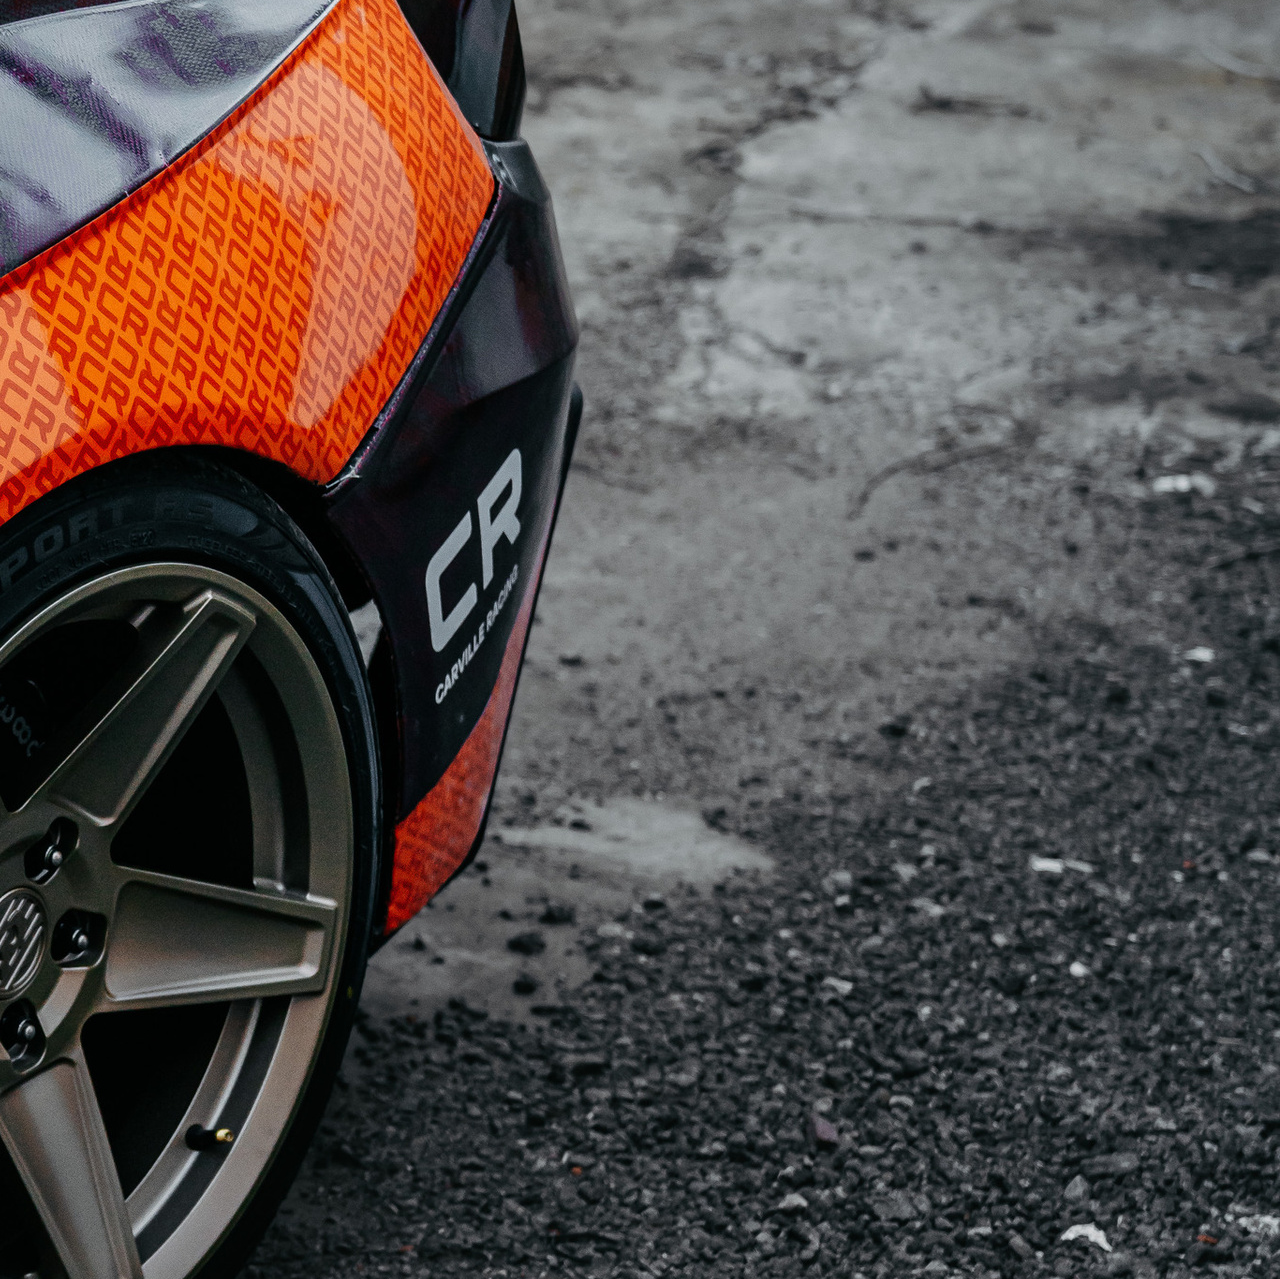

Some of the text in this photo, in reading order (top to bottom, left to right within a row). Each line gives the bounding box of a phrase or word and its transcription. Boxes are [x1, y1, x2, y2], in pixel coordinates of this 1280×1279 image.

[425, 447, 523, 653] CR
[434, 563, 519, 704] CARVILLE RACING
